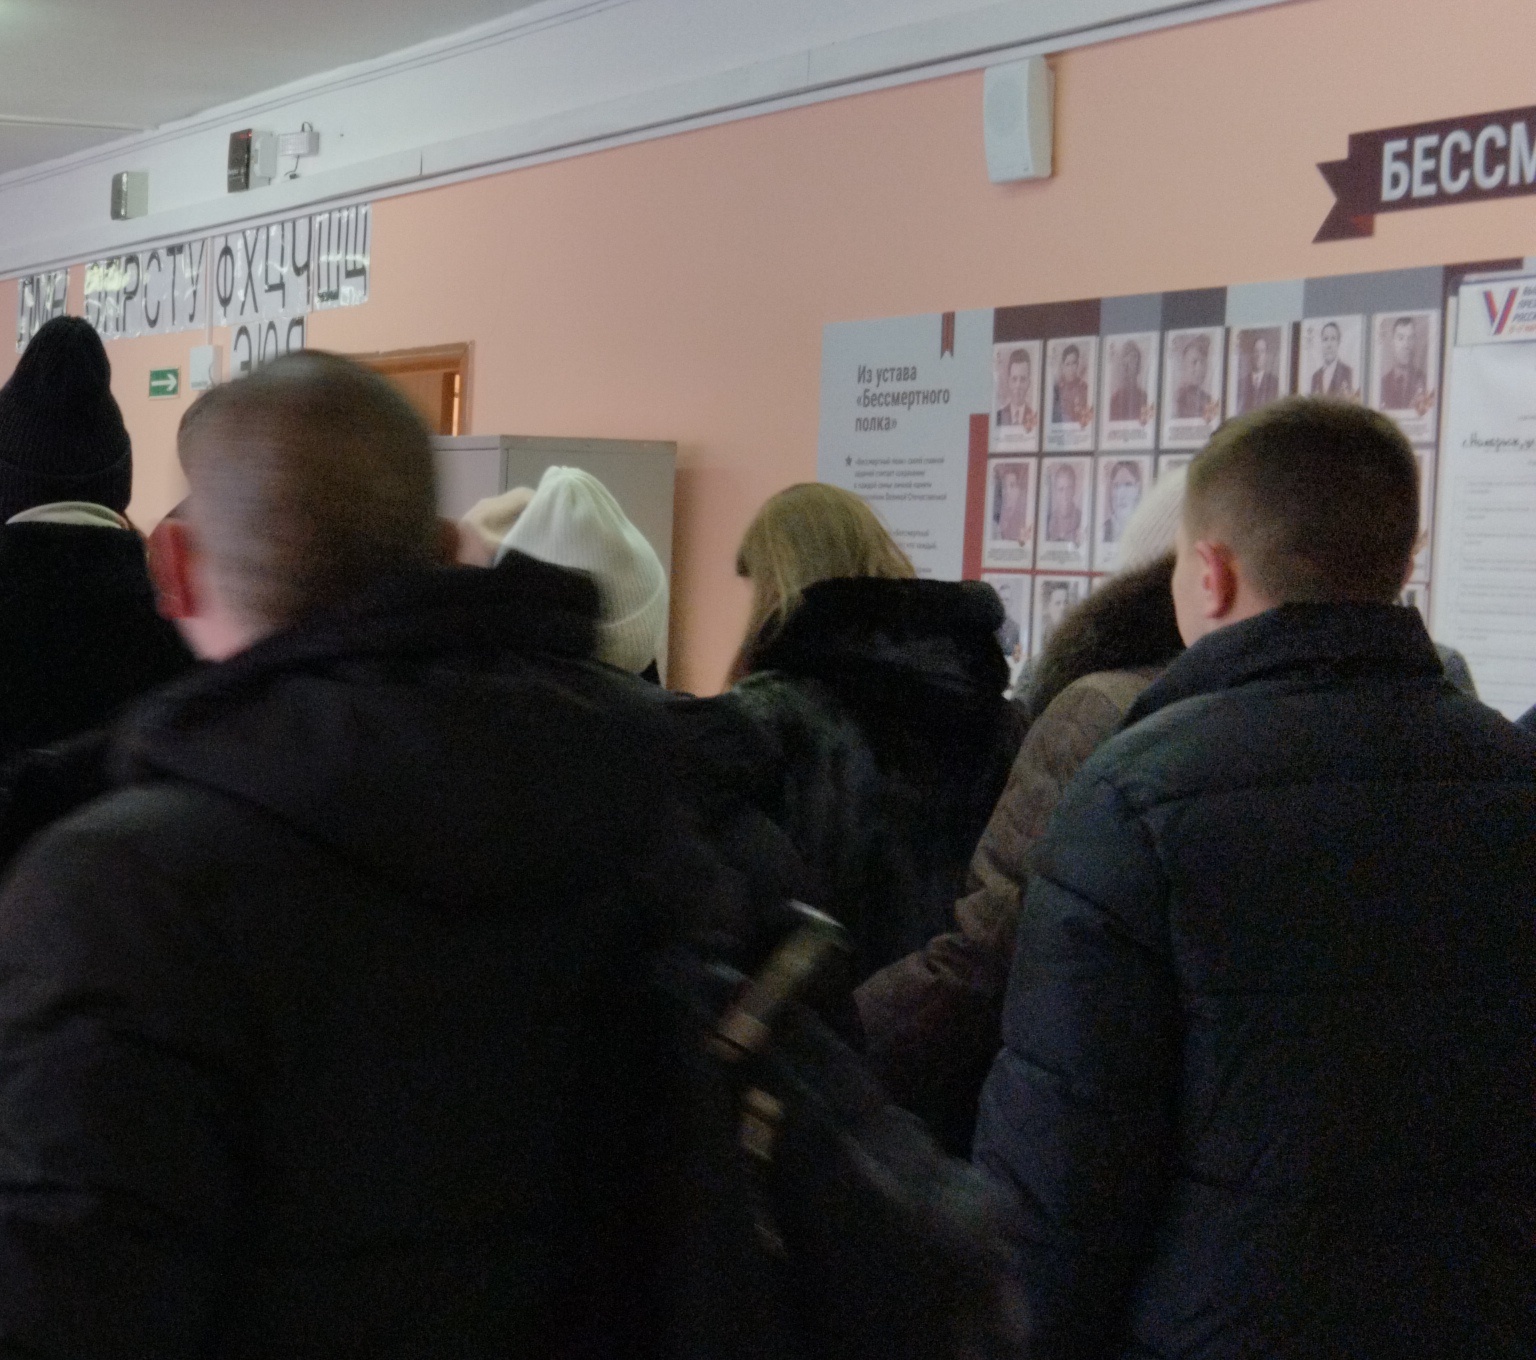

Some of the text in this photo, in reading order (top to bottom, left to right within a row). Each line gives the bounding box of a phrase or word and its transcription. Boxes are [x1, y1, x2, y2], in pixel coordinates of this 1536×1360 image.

[857, 365, 917, 388] Из устава
[856, 388, 950, 411] «Бессмертного
[855, 416, 897, 432] полка»
